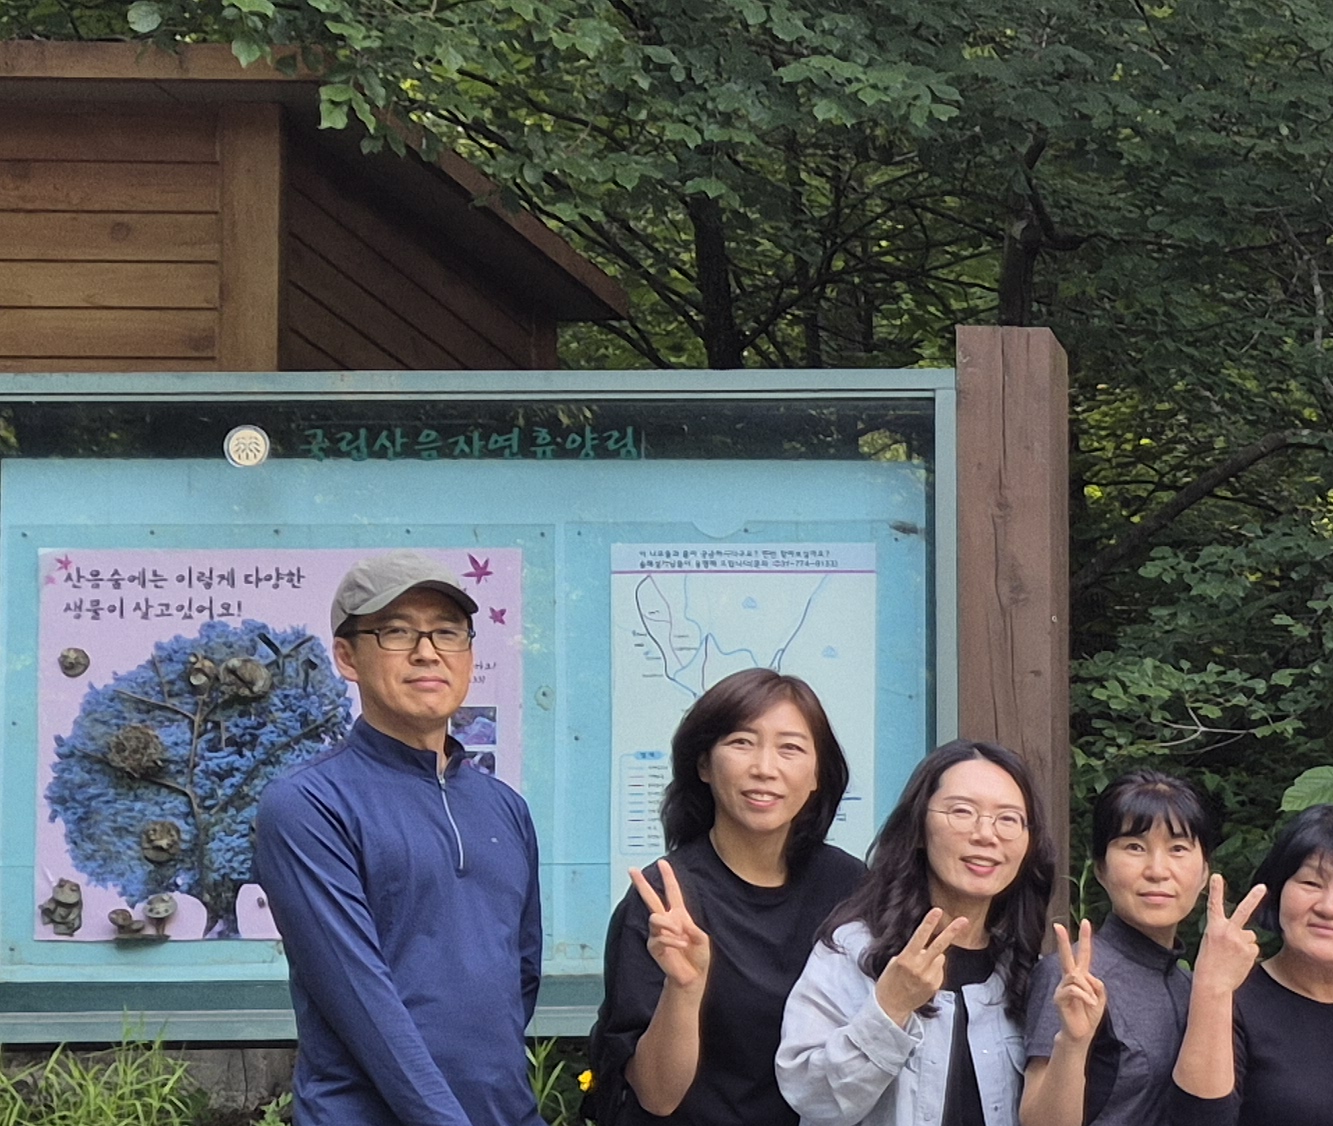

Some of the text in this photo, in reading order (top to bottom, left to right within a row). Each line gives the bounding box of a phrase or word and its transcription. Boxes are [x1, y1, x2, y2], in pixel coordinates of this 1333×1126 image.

[302, 425, 636, 460] 국립산음자연휴양림
[64, 565, 306, 589] 산음숲에는 이렇게 다양한
[64, 596, 243, 620] 생물이 살고있어요!
